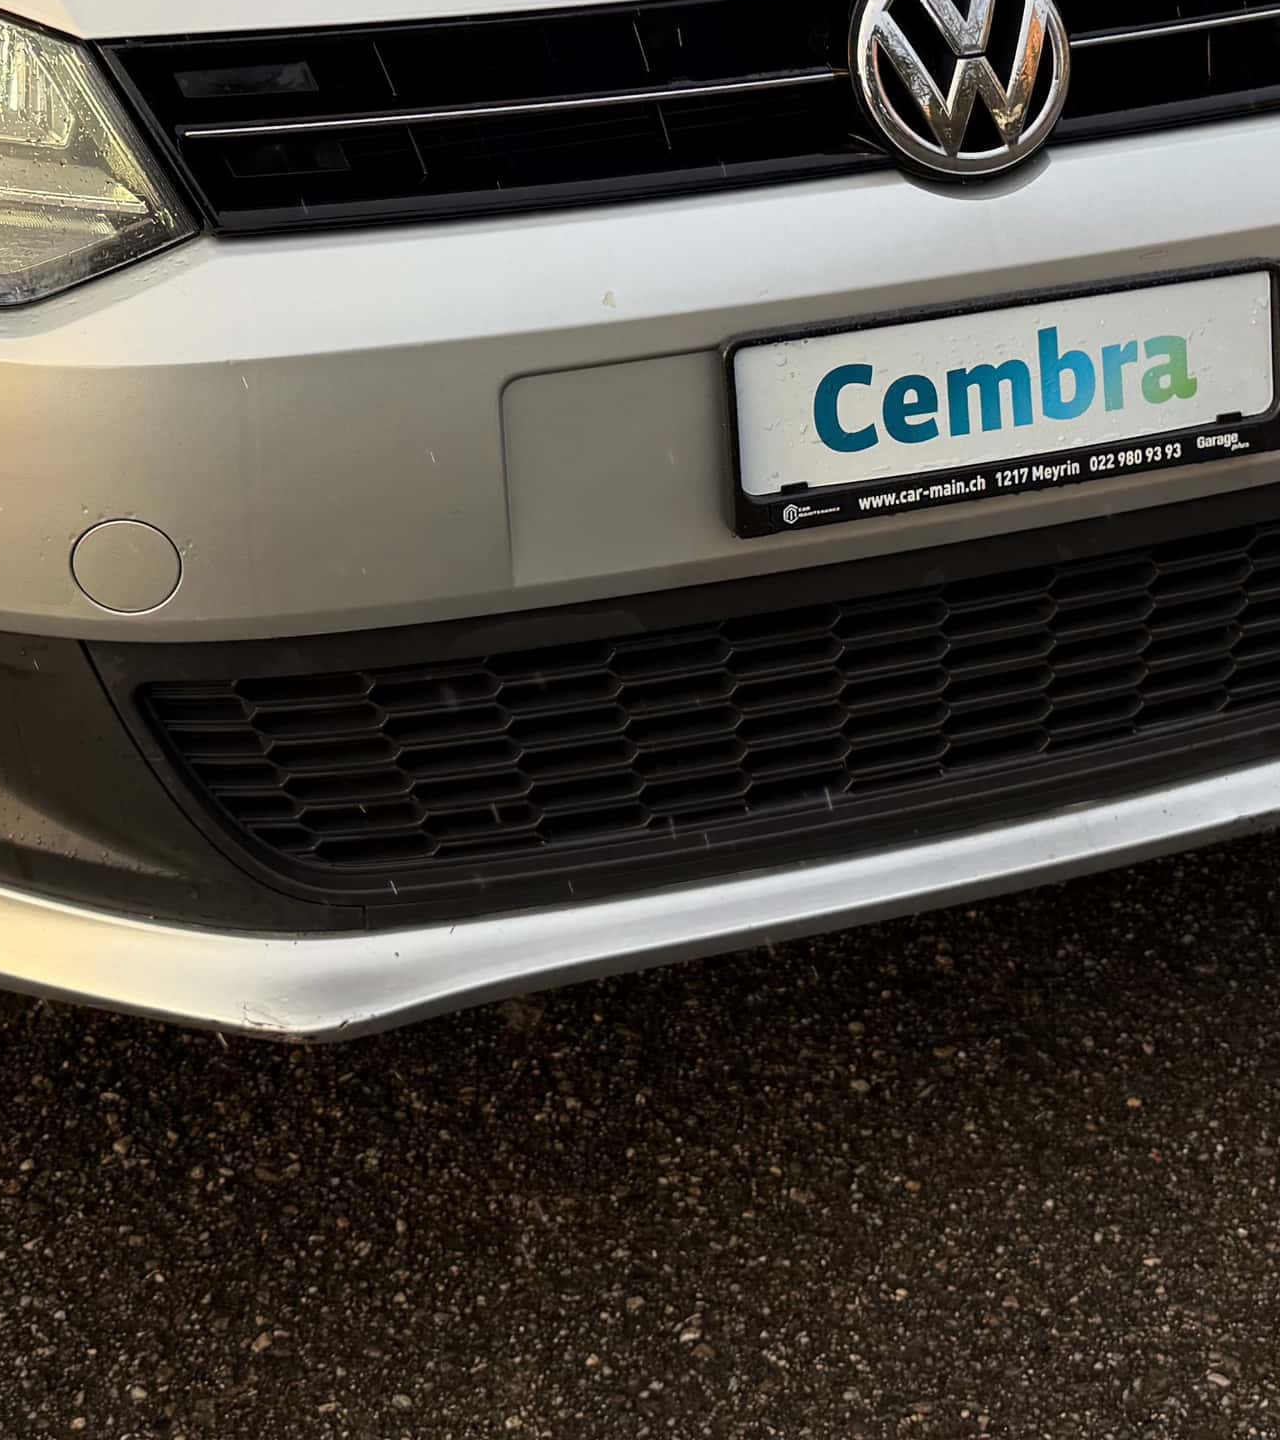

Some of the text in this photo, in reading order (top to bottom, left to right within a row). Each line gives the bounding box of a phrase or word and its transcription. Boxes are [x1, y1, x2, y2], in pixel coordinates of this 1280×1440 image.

[814, 327, 1198, 453] Cembra
[1196, 432, 1239, 449] Garage
[858, 443, 1182, 511] www.car-main.ch 1217 Meyrin 022 980 93 93
